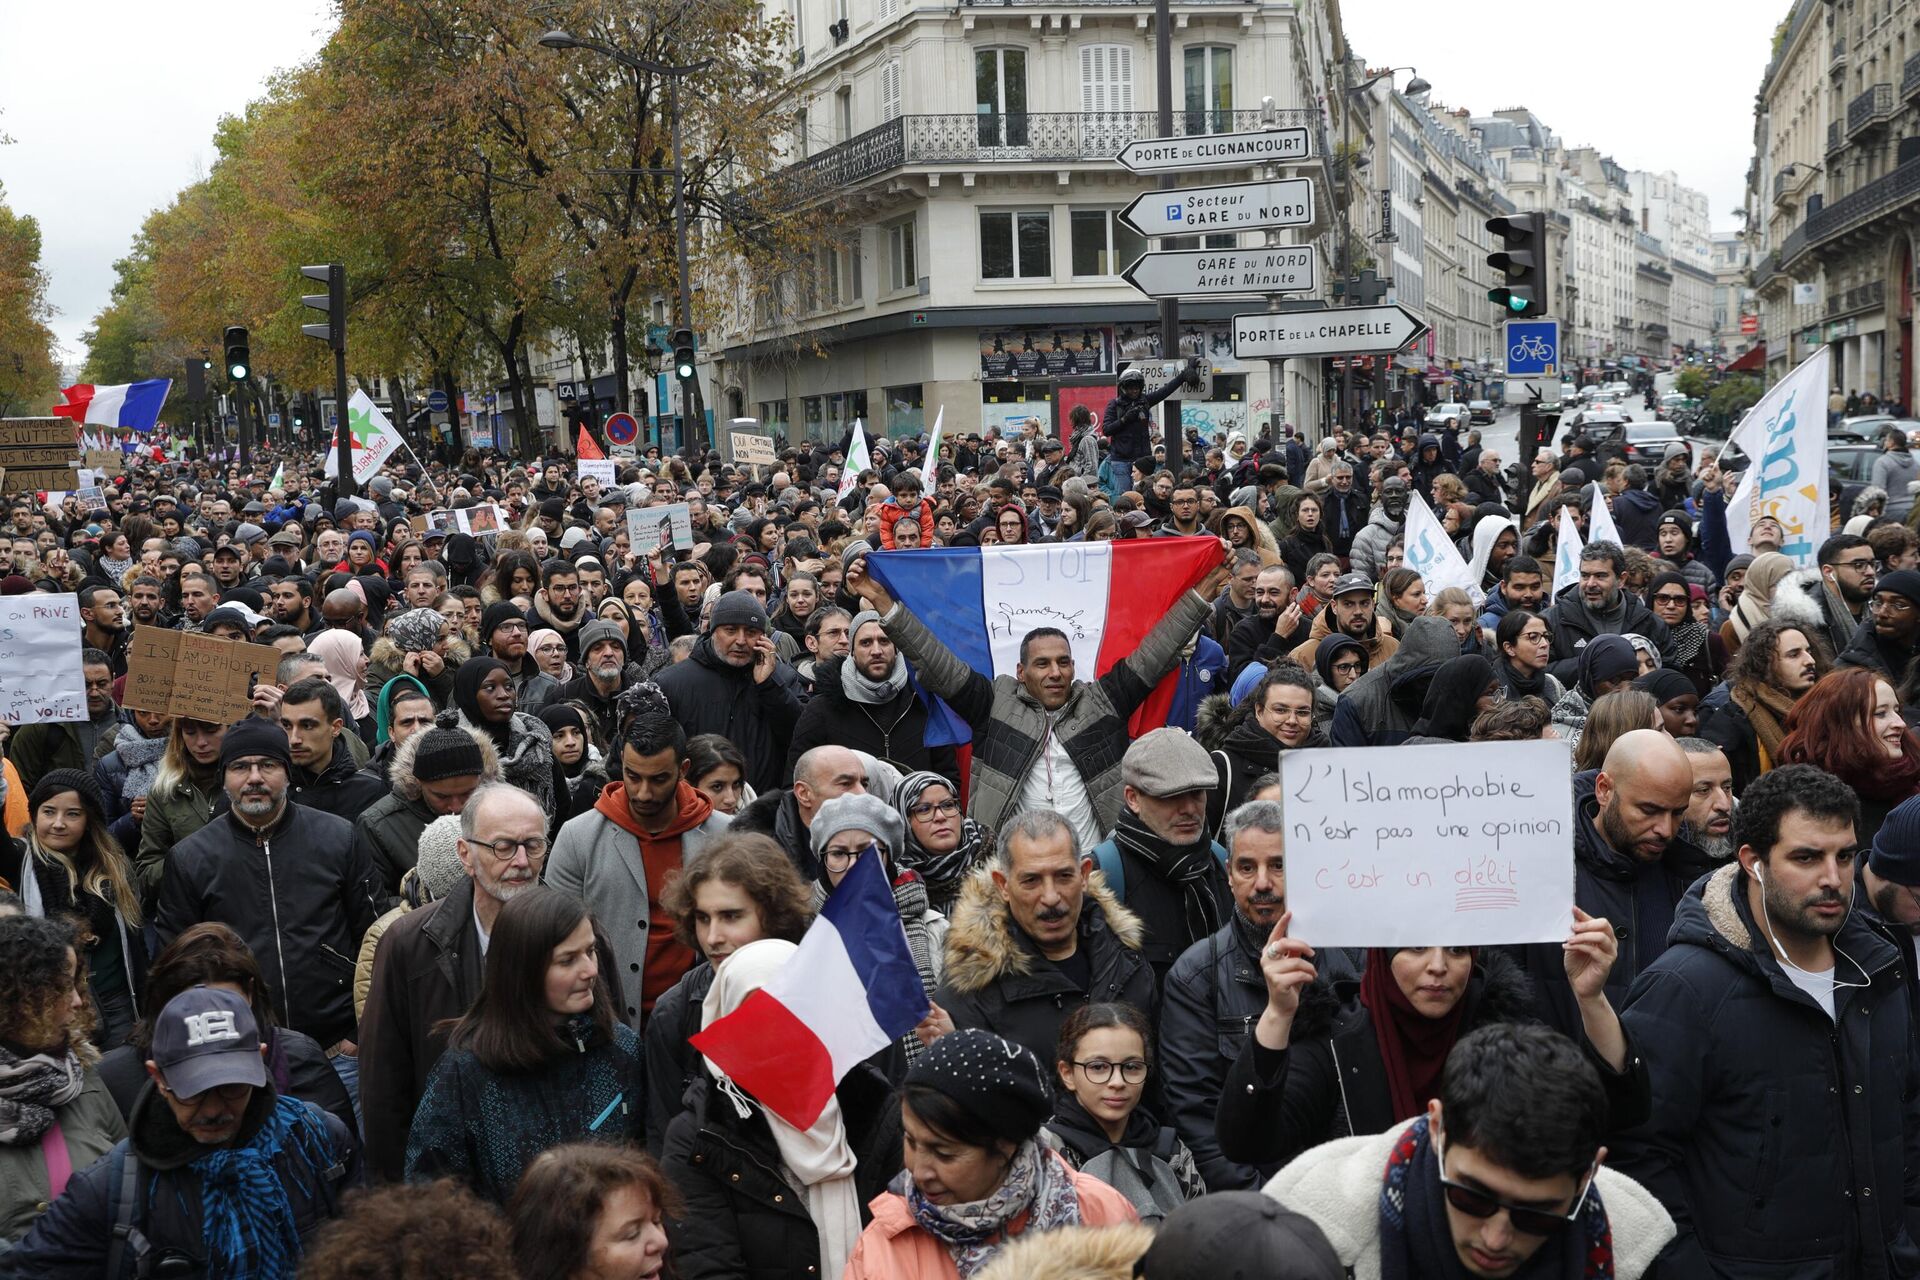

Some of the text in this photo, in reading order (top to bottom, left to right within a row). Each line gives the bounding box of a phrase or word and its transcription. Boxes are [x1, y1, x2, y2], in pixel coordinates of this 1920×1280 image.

[1135, 138, 1301, 162] PORTE DE CLIGNANCOURT
[1187, 194, 1245, 208] Secteur
[1187, 204, 1304, 224] GARE DU NORD
[1382, 192, 1390, 235] HOTEL
[1198, 254, 1307, 270] GARE DU NORD
[1198, 273, 1295, 287] Arrêt Minute
[1240, 329, 1285, 342] PORTE
[1290, 332, 1300, 340] DE
[1319, 322, 1392, 338] CHAPELLE
[14, 428, 72, 444] LUTTES
[22, 450, 36, 462] NE
[40, 450, 78, 462] SOMMES
[736, 450, 748, 458] NON
[998, 546, 1108, 586] STOP
[145, 644, 272, 674] ISLAMOPHOBIE
[136, 674, 156, 684] 80%
[190, 669, 216, 682] TUE
[1294, 816, 1560, 851] n'est pas une opinion
[1406, 872, 1432, 887] un
[1454, 854, 1518, 886] délit
